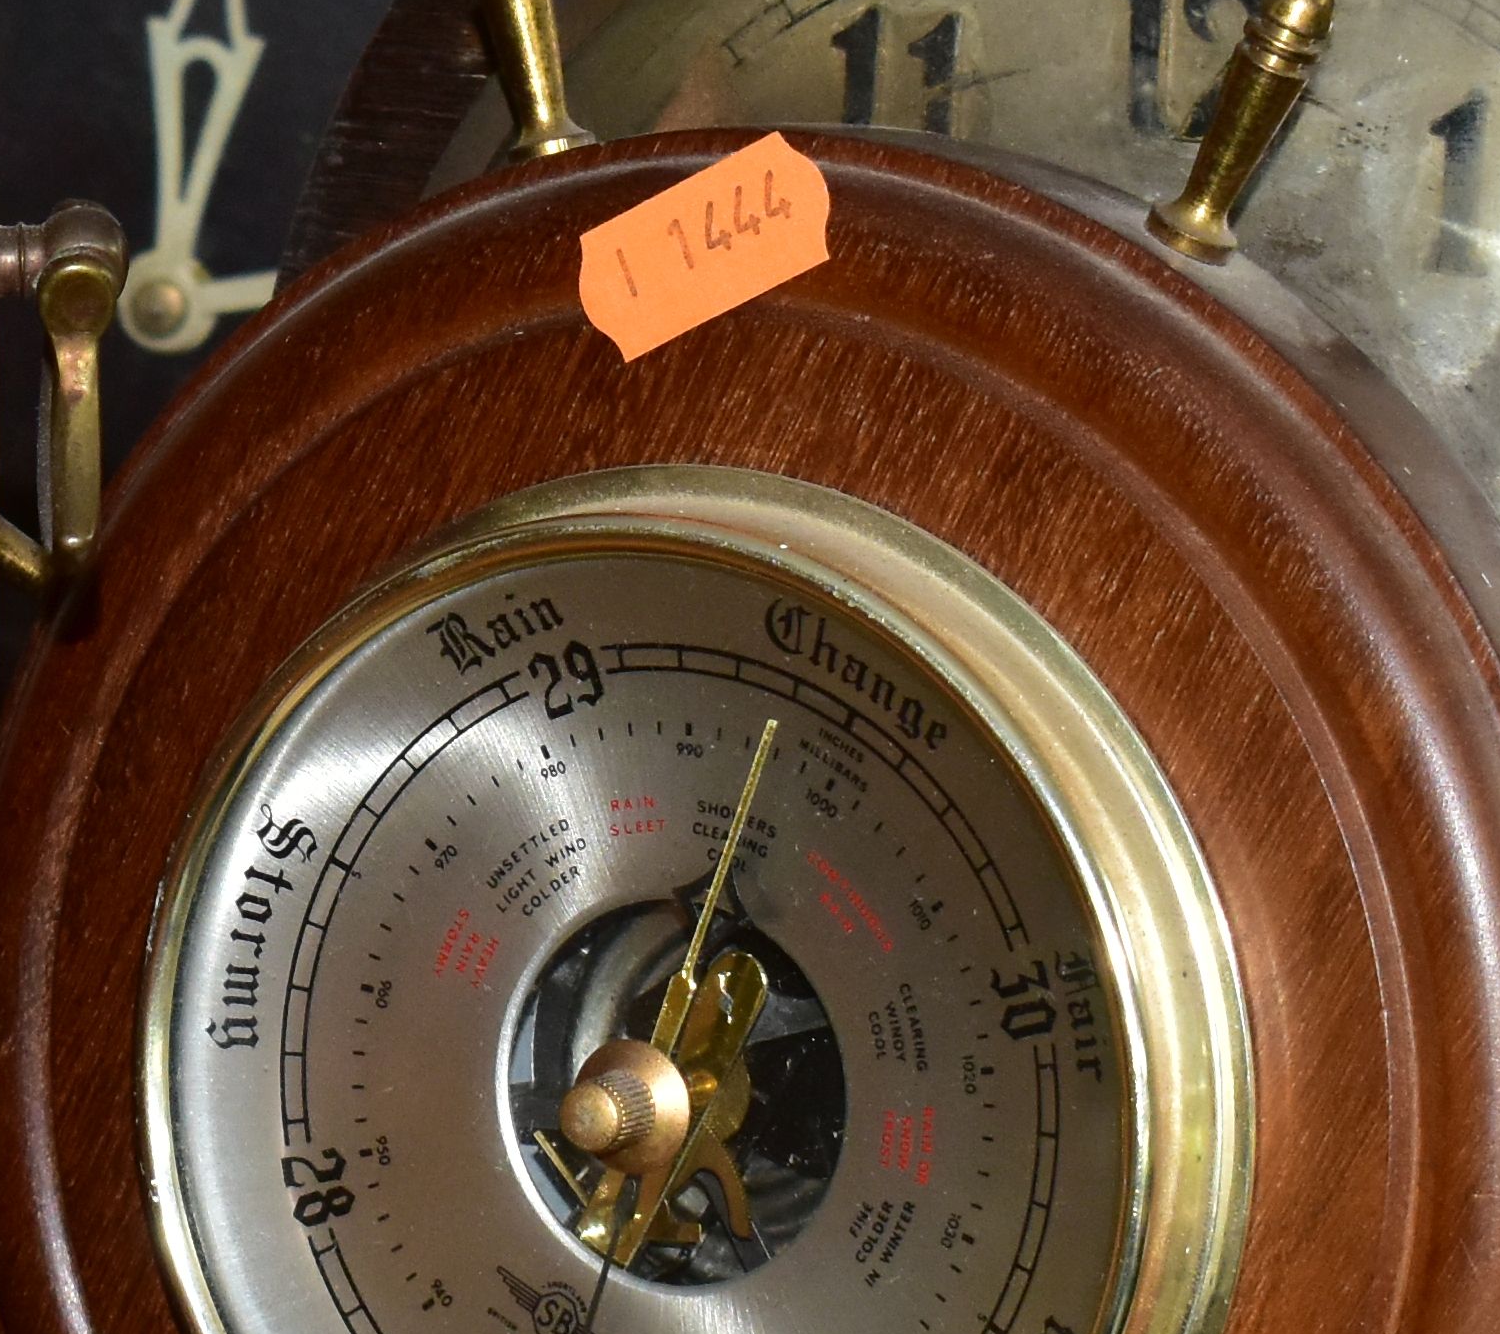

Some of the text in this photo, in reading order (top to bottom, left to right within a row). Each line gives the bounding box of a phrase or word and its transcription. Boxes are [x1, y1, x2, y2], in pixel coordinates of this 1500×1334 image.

[831, 6, 962, 135] 11
[1428, 87, 1489, 278] 1
[668, 169, 791, 269] 1444
[426, 593, 564, 676] Rain
[527, 640, 604, 720] 29
[765, 597, 948, 751] Change
[541, 761, 566, 779] 980
[676, 742, 703, 759] 990
[800, 739, 868, 793] MILLIBARS
[819, 728, 865, 763] INCHES
[610, 796, 657, 812] RAIN
[610, 819, 665, 837] SLEET
[696, 799, 777, 839] SHOERS
[806, 788, 838, 818] 1000
[435, 844, 459, 870] 970
[487, 818, 570, 890] UNSETTLED
[692, 821, 769, 860] CLEAING
[706, 847, 748, 874] COL
[496, 838, 587, 914] LIGHT WIND
[522, 867, 582, 917] COLDER
[205, 803, 318, 1049] Stormy
[908, 898, 932, 931] 1010
[433, 908, 470, 978] STORMY
[455, 933, 483, 974] RAIN
[471, 937, 499, 988] HEAVY
[375, 980, 393, 1009] 960
[990, 960, 1058, 1040] 30
[1055, 950, 1103, 1084] Fair
[868, 1011, 890, 1060] COOL
[884, 1000, 907, 1063] WINDY
[899, 983, 928, 1073] CLEARING
[962, 1054, 977, 1095] 1020
[376, 1135, 391, 1166] 950
[281, 1147, 356, 1227] 28
[849, 1201, 874, 1238] FINE
[855, 1200, 895, 1264] COLDER
[864, 1200, 917, 1288] IN WINTER
[431, 1278, 453, 1308] 940
